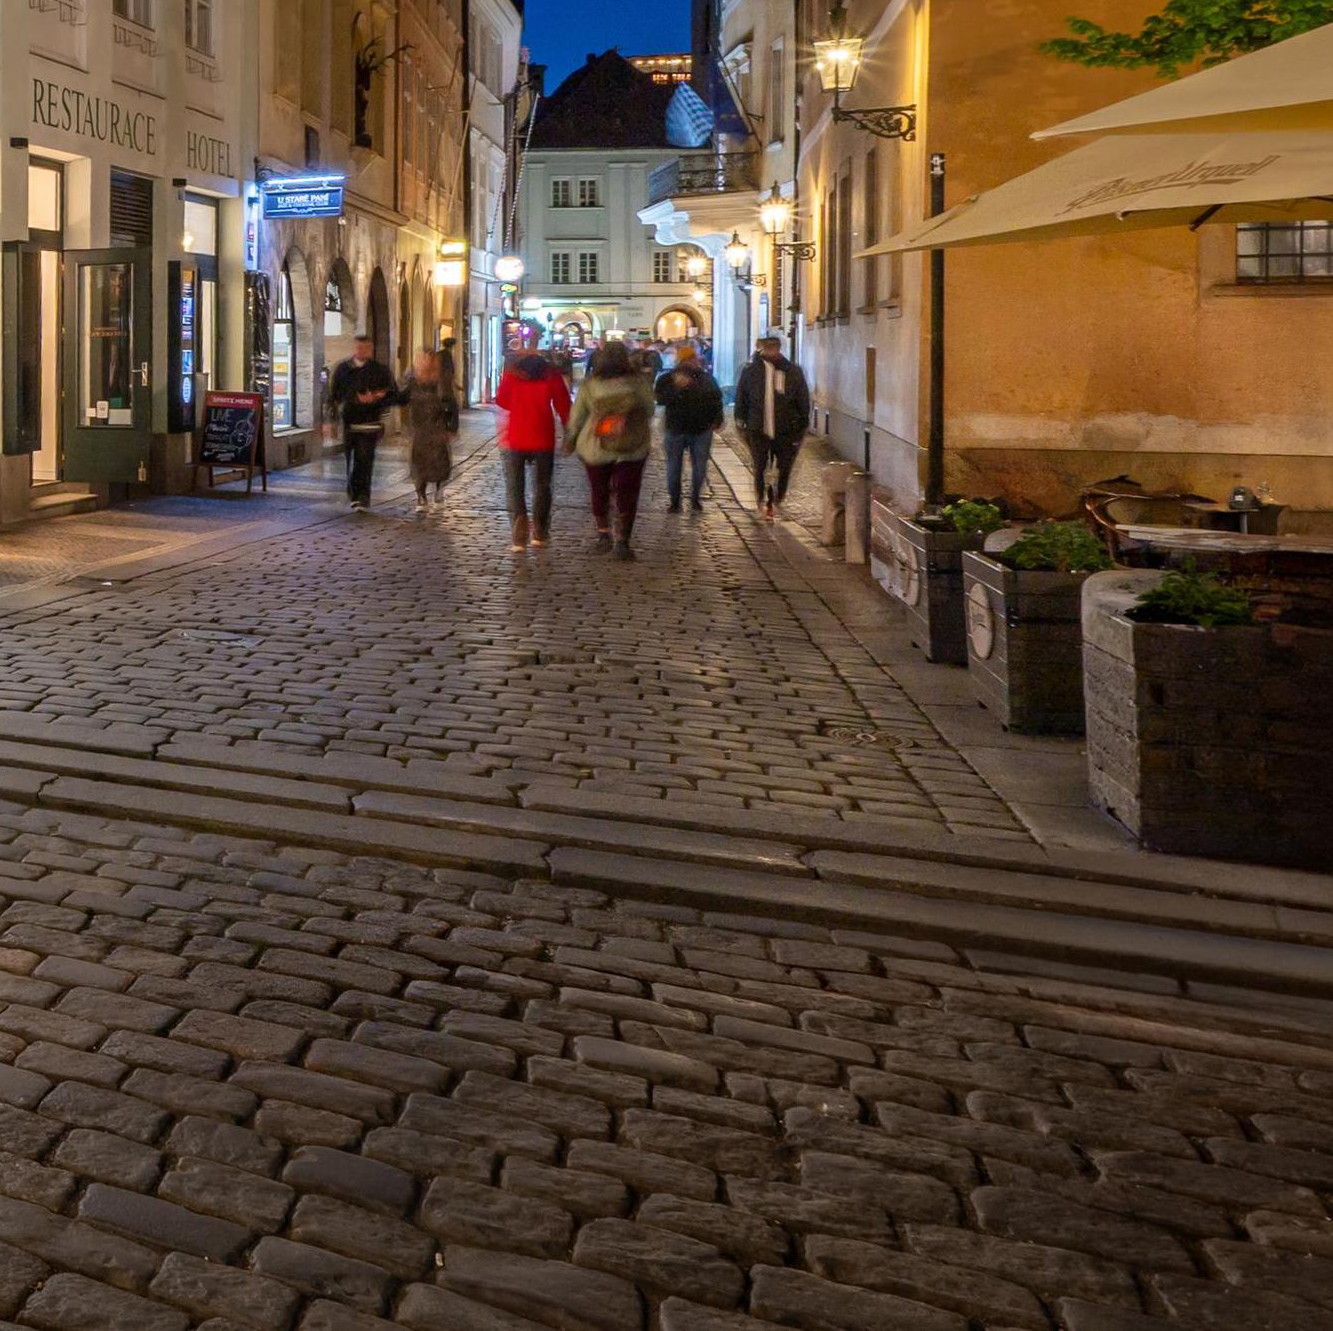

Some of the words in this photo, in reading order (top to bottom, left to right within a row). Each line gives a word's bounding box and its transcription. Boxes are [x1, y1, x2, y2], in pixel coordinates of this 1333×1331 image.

[33, 78, 157, 156] RESTAURACE
[186, 130, 235, 179] HOTEL
[277, 196, 285, 204] U
[285, 194, 309, 204] STARÉ
[310, 192, 330, 203] PANÍ
